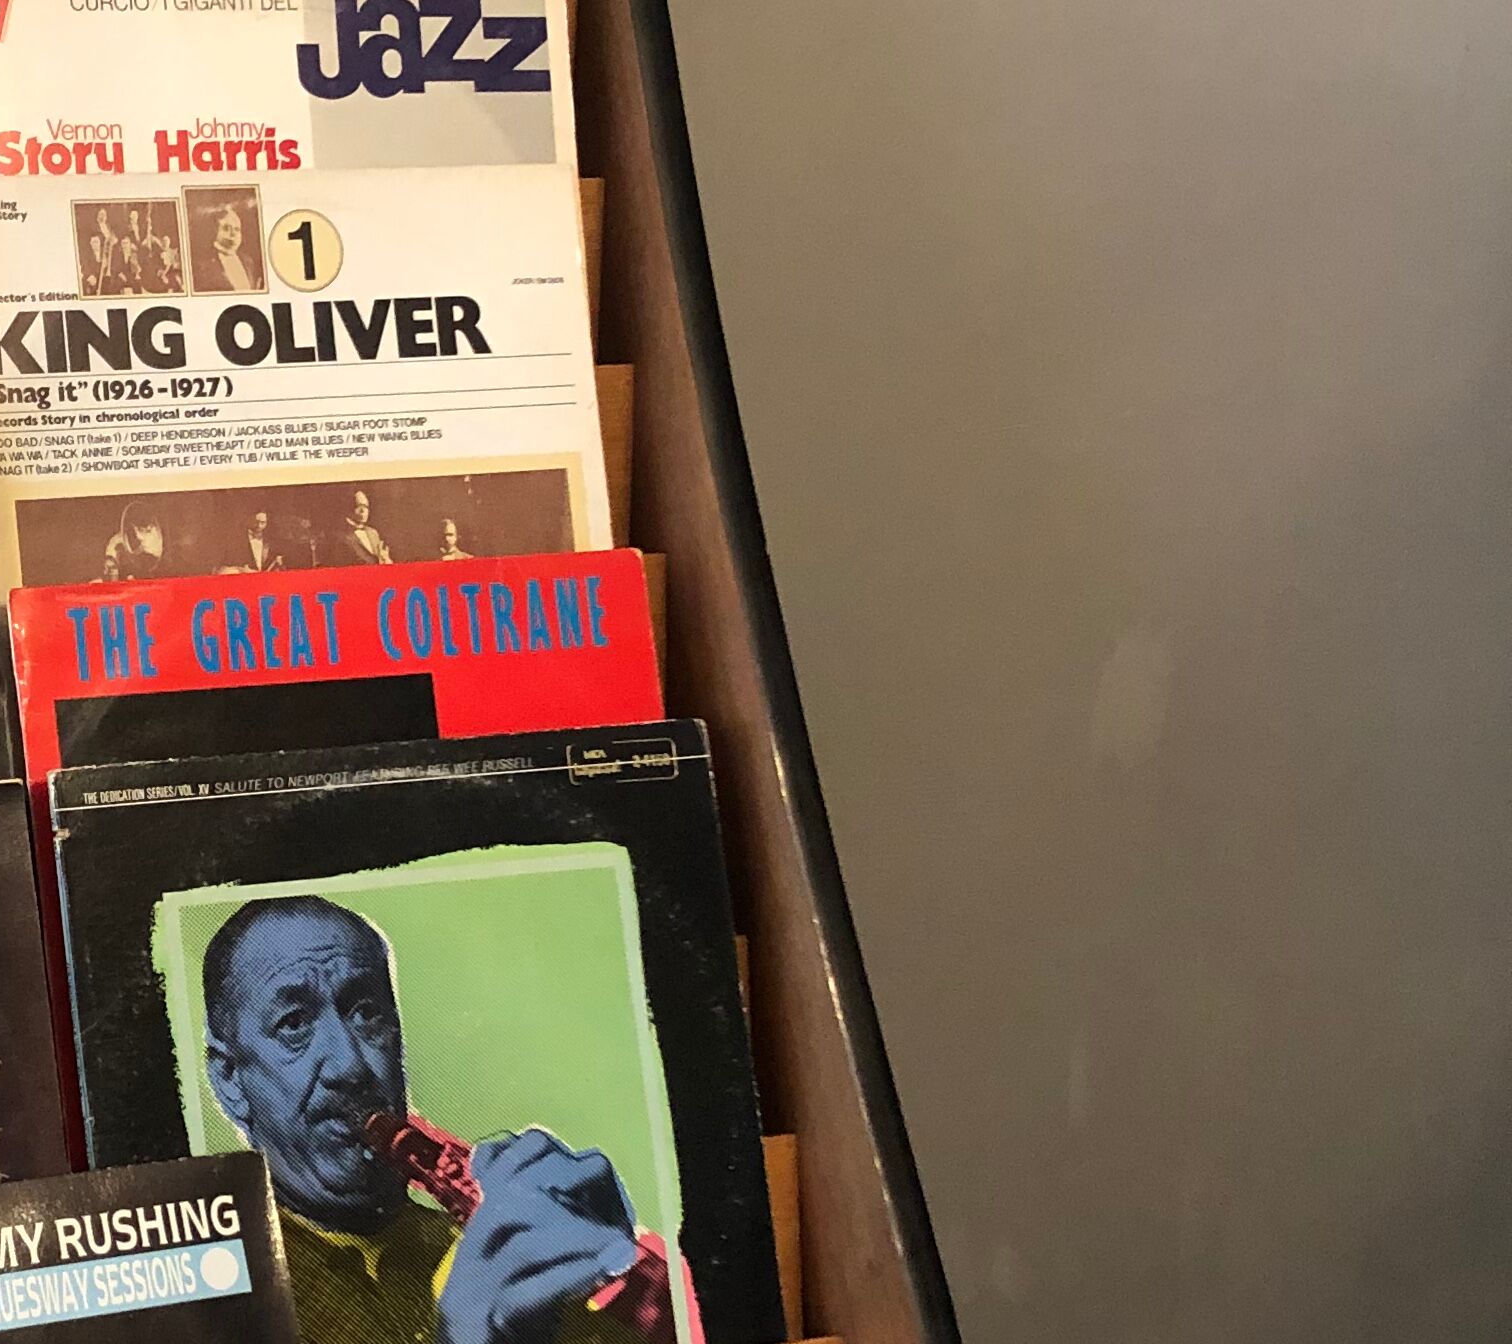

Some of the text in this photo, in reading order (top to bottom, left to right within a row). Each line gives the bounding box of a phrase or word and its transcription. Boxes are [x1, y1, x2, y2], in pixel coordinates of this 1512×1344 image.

[46, 117, 265, 141] Vernon Johnny
[154, 128, 301, 174] Harris
[288, 221, 317, 281] 1
[38, 291, 79, 302] Edition
[214, 296, 493, 367] OLIVER
[40, 413, 76, 427] Story
[78, 412, 90, 424] in
[95, 408, 180, 423] chronological
[184, 406, 219, 418] order
[130, 431, 158, 442] DEEP
[161, 427, 226, 440] HENDERSON
[235, 425, 282, 436] JACKASS
[285, 422, 318, 433] BLUES
[325, 420, 360, 431] SUGAR
[362, 418, 390, 429] FOOT
[392, 416, 427, 427] STOMP
[9, 452, 25, 461] WA
[26, 451, 43, 461] WA
[51, 449, 78, 459] TACK
[81, 447, 113, 458] ANNIE
[121, 444, 170, 456] SOMEDAY
[254, 438, 282, 449] DEAD
[285, 437, 309, 447] MAN
[311, 435, 344, 446] BLUES
[352, 433, 375, 443] NEW
[378, 431, 408, 442] WANG
[410, 429, 442, 440] BLUES
[25, 465, 34, 475] IT
[35, 463, 60, 475] (take
[61, 463, 72, 473] 2)
[81, 460, 140, 472] SHOWBOAT
[143, 456, 191, 469] SHUFFLE
[199, 454, 233, 465] EVERY
[302, 449, 322, 459] THE
[325, 447, 369, 458] WEEPER
[66, 576, 609, 682] THE GREAT COLTRANE
[83, 791, 98, 804] THE
[99, 788, 145, 803] DEDICATION
[197, 783, 210, 795] XV
[214, 778, 262, 794] SALUTE
[267, 776, 284, 789] TO
[288, 771, 349, 787] NEWPORT
[482, 757, 534, 772] RUSSELL
[55, 1194, 241, 1260] RUSHING
[93, 1251, 197, 1308] SESSIONS
